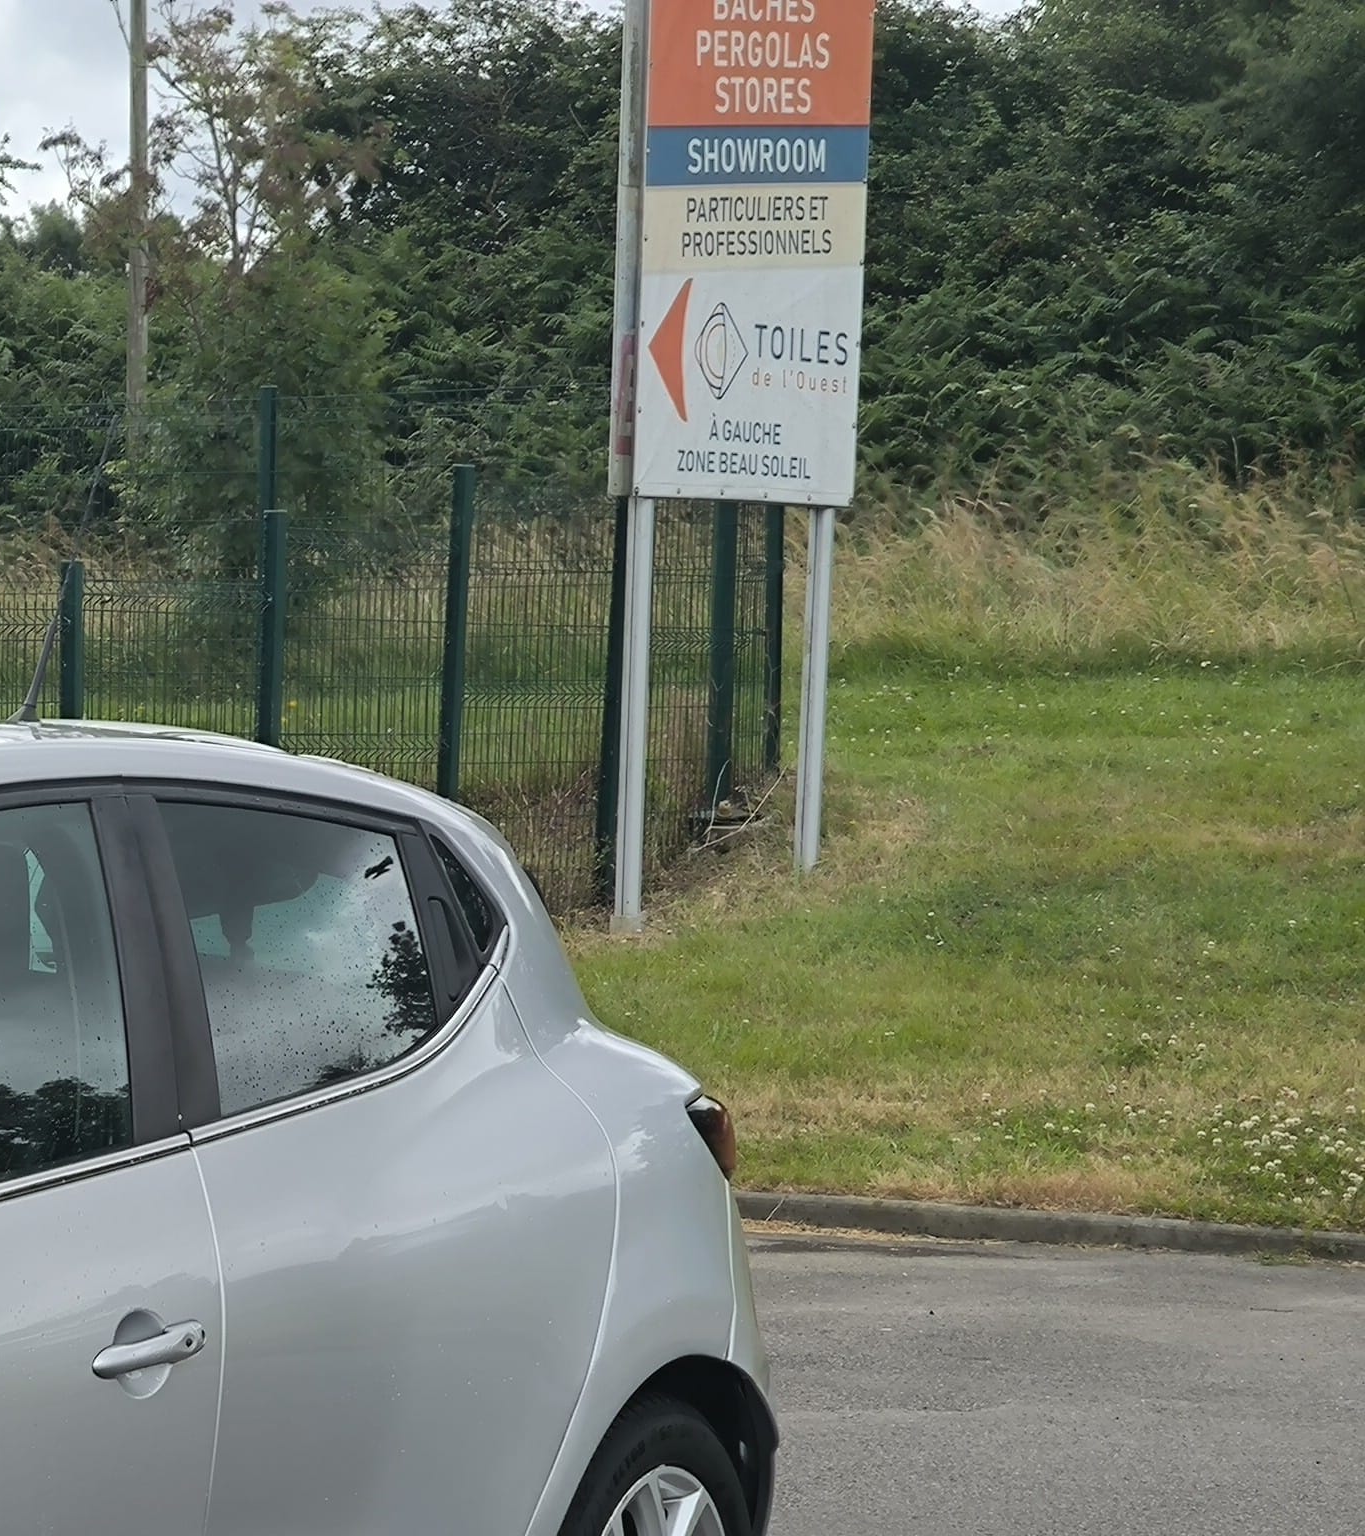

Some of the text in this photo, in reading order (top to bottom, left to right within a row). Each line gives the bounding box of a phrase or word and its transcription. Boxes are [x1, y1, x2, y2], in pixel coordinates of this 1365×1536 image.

[696, 30, 830, 69] PERGOLAS
[715, 76, 812, 114] STORES
[687, 137, 827, 174] SHOWROOM
[686, 196, 829, 223] PARTICULIERS ET
[682, 229, 832, 257] PROFESSIONNELS
[754, 324, 848, 366] TOILES
[752, 368, 847, 393] de l'Ouest
[709, 412, 781, 445] À GAUCHE
[677, 450, 811, 479] ZONE BEAU SOLEIL
